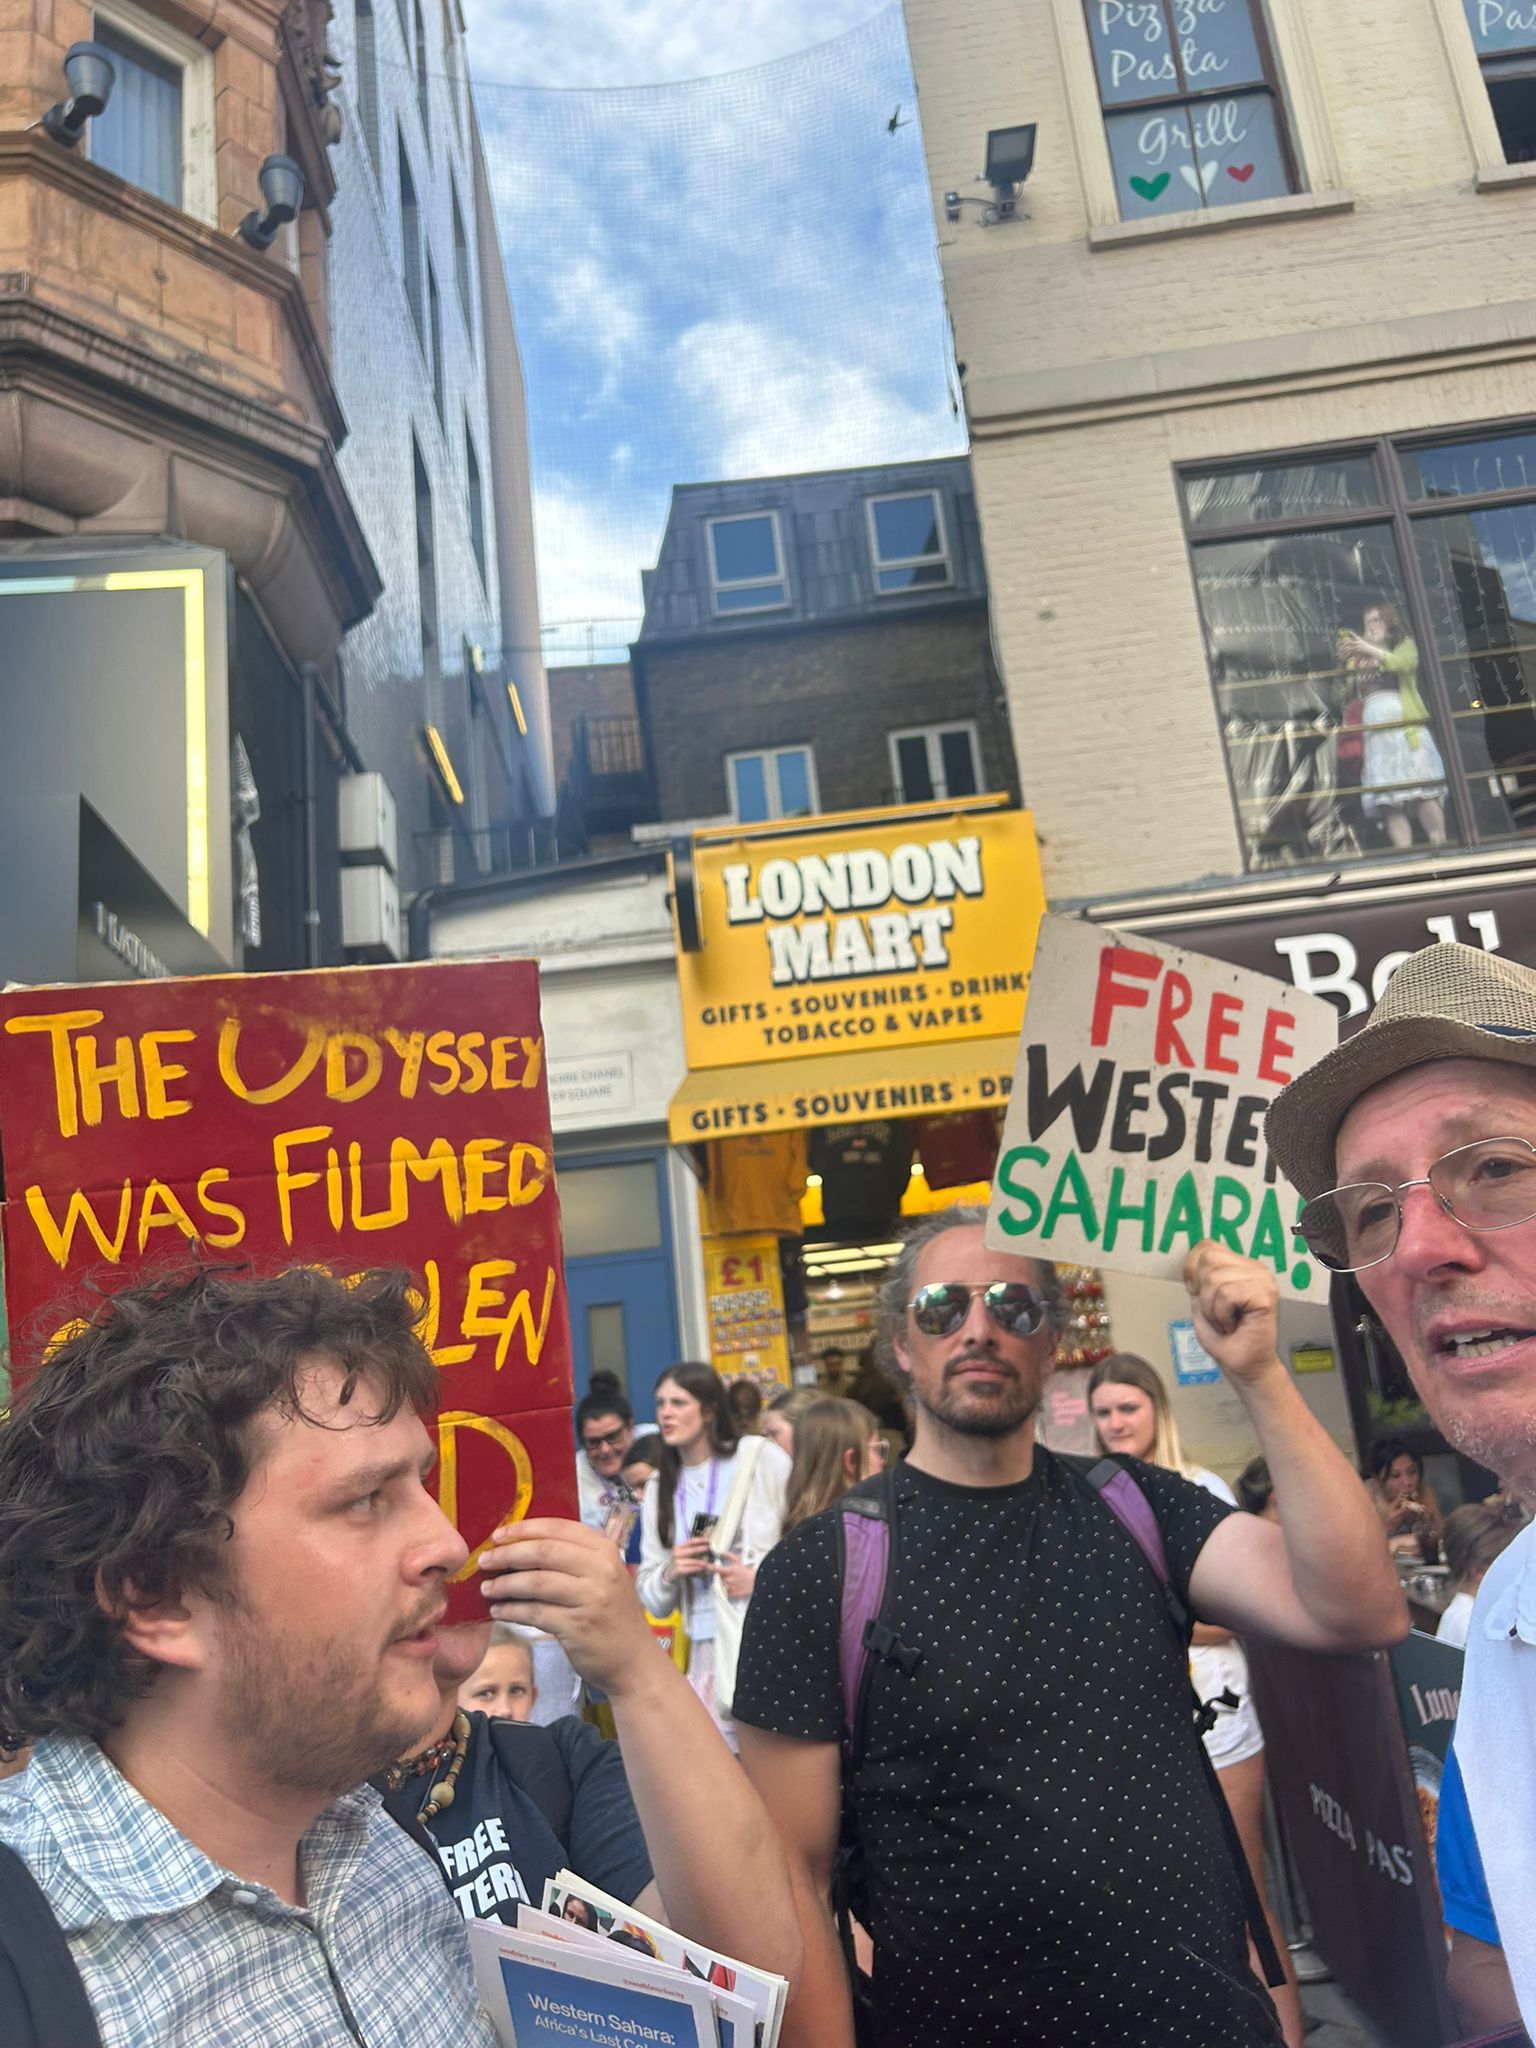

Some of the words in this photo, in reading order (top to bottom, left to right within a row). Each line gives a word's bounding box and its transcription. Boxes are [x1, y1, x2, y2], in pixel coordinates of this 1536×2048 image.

[1478, 0, 1536, 37] Pa
[1110, 37, 1229, 88] Pasta
[723, 836, 984, 924] LONDON
[767, 906, 953, 986] MART
[701, 1001, 767, 1026] GIFTS
[790, 984, 928, 1014] SOUVENIRS
[763, 1017, 875, 1046] TOBACCO
[884, 1015, 899, 1031] &
[907, 1005, 983, 1029] VAPES
[1091, 946, 1296, 1086] FREE
[5, 1009, 198, 1138] THE
[691, 1103, 768, 1131] GIFTS
[794, 1082, 954, 1118] SOUVENIRS
[1026, 1043, 1288, 1184] WESTE
[26, 1168, 246, 1270] WAS
[273, 1126, 547, 1246] FILMED
[997, 1145, 1312, 1290] SAHARA!
[721, 1255, 764, 1286] £1
[438, 1817, 510, 1880] FREE
[1365, 1829, 1414, 1887] PAS
[528, 1993, 606, 2027] Western
[608, 2014, 676, 2046] Sahara:
[535, 2015, 589, 2040] Africa's
[590, 2028, 621, 2048] Last
